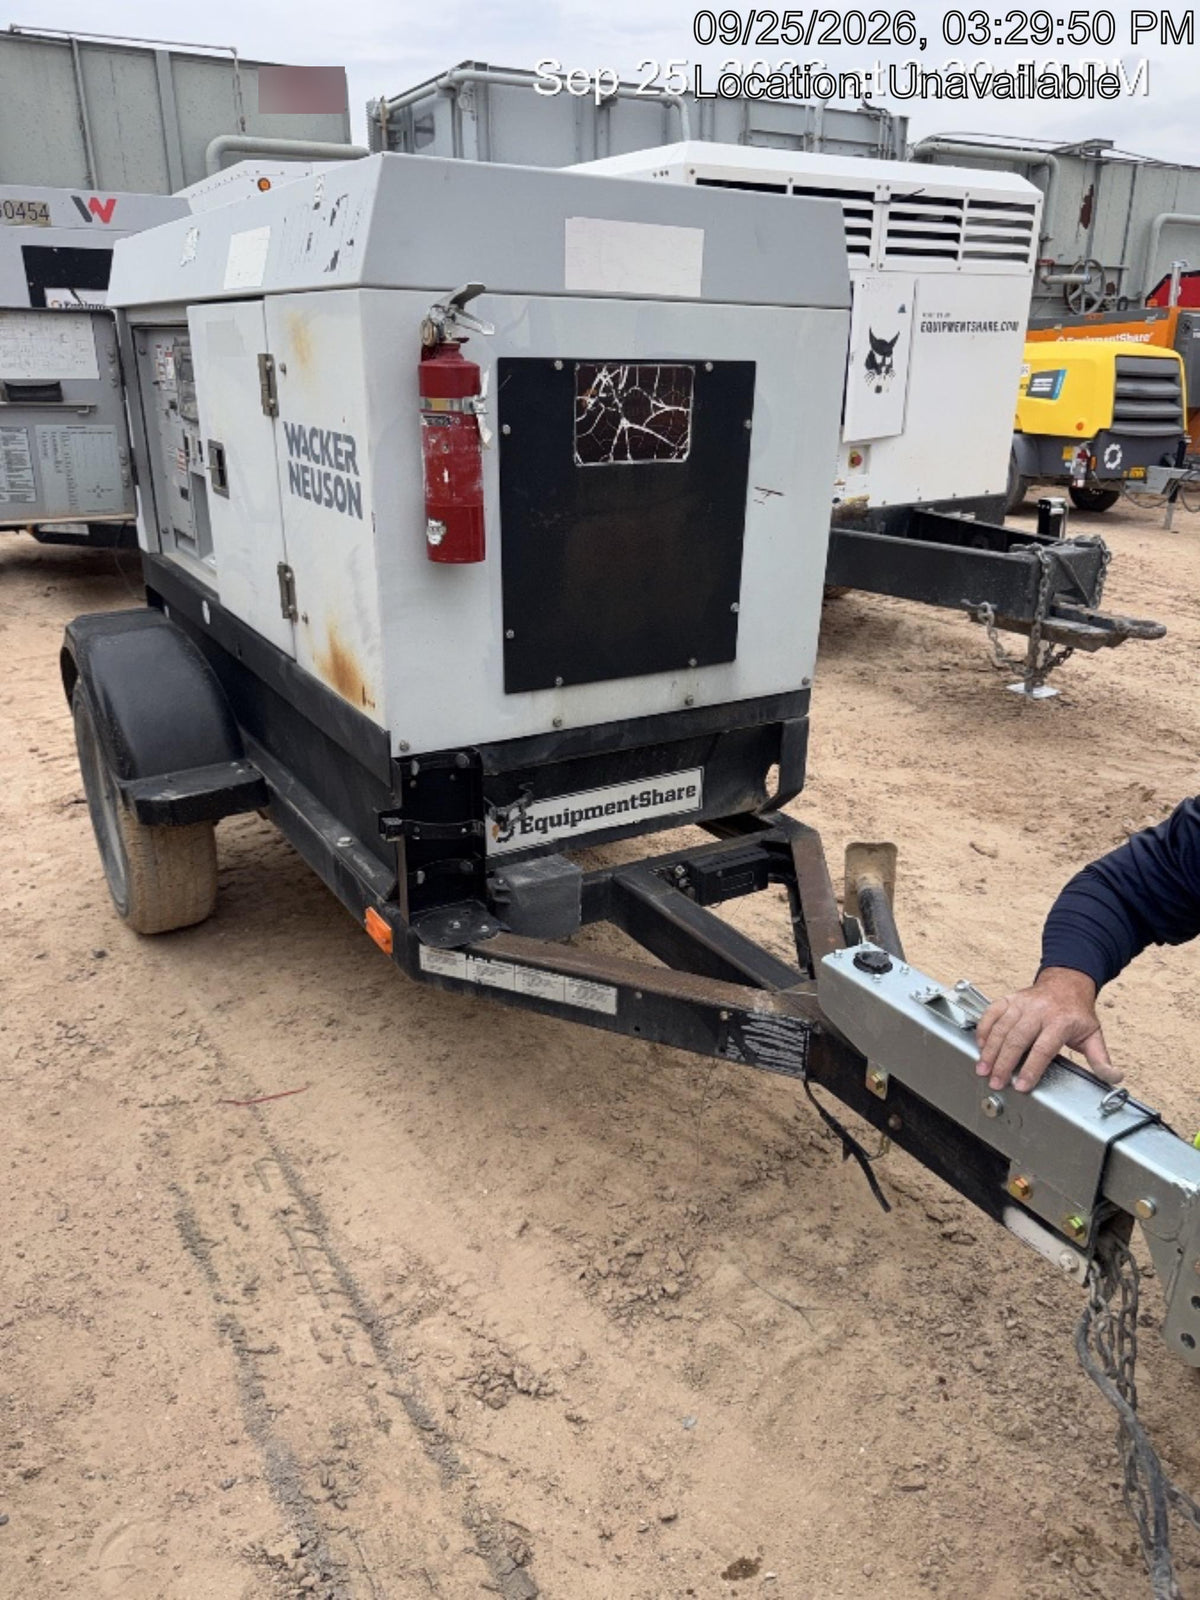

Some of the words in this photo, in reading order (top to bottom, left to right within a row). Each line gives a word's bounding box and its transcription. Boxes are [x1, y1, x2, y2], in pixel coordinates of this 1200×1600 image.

[0, 200, 50, 221] 0454
[920, 320, 1019, 334] EQUIPMENTSHARE.COM
[283, 421, 360, 477] WACKER
[288, 460, 363, 520] NEUSON
[520, 784, 697, 835] EquipmentShare
